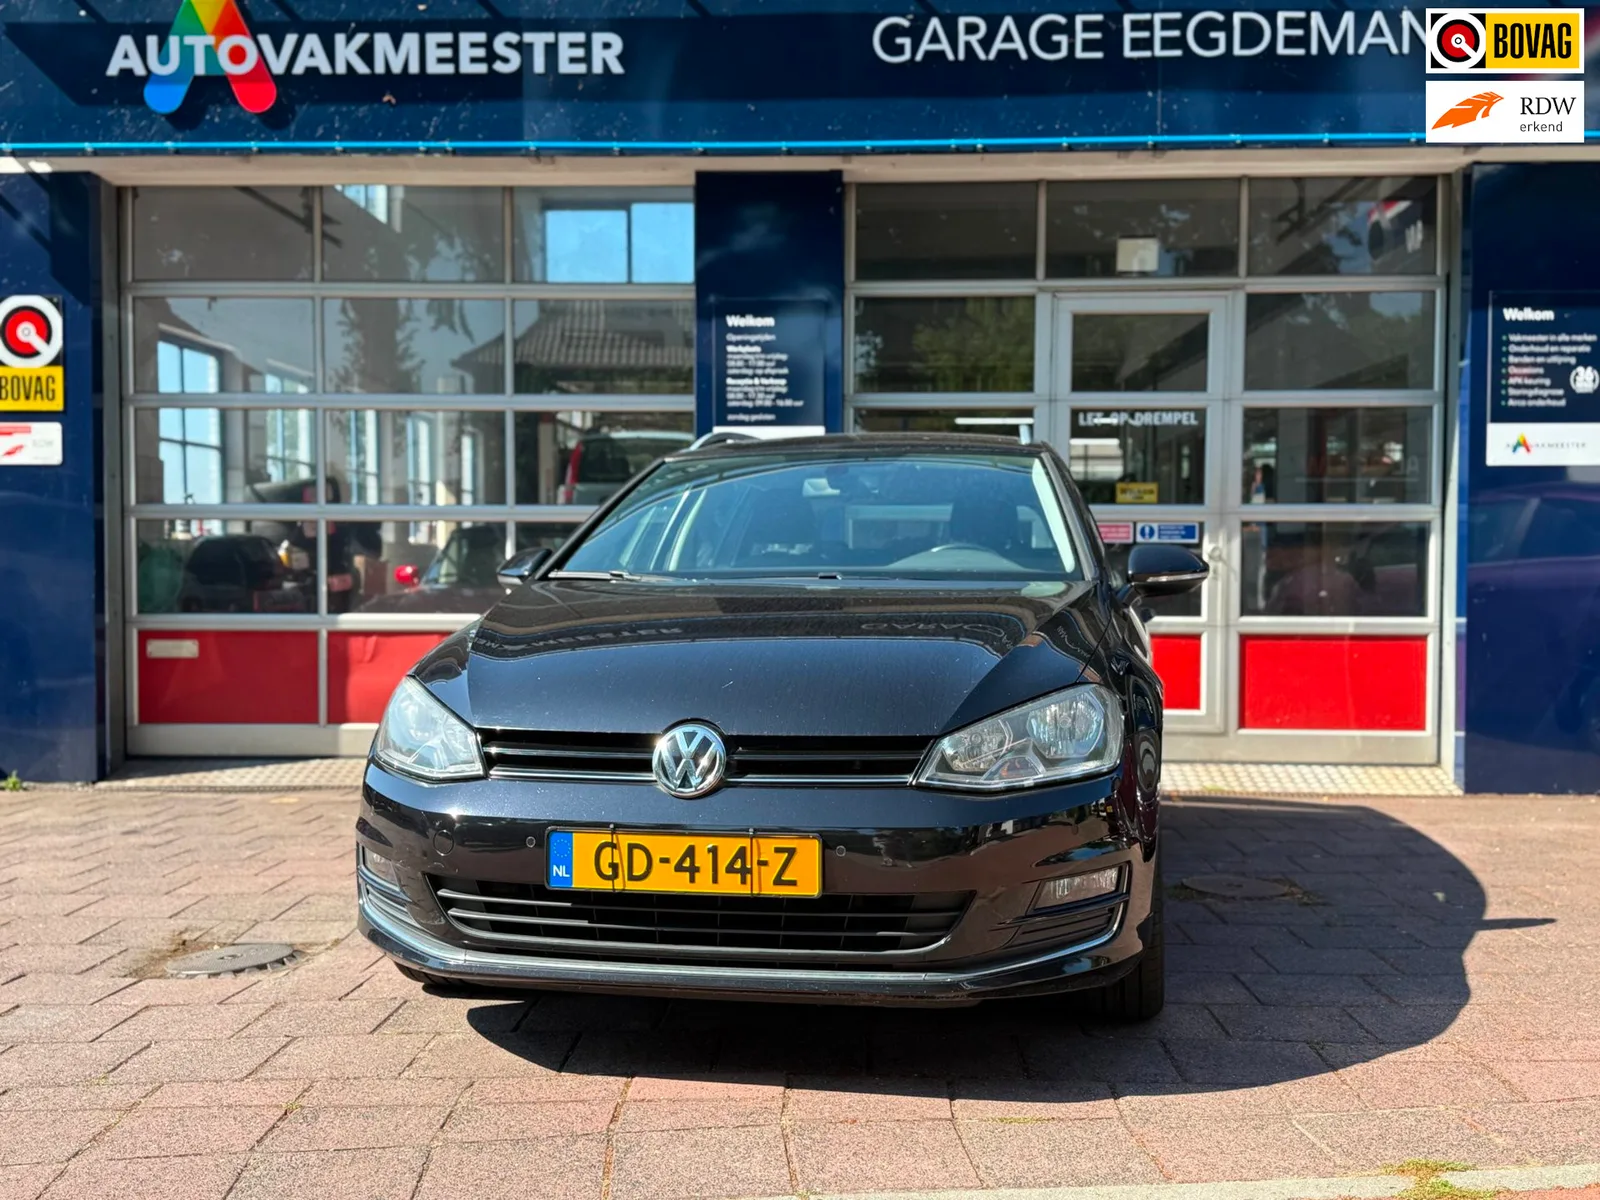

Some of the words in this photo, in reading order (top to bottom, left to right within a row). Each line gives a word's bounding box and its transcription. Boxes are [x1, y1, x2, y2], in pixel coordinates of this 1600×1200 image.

[872, 13, 1105, 64] GARAGE
[105, 31, 625, 77] AUTOVAKMEESTER
[1503, 307, 1556, 321] Welkom
[0, 375, 56, 401] BOVAG
[1134, 411, 1198, 426] DREMPEL
[552, 864, 570, 878] NL
[594, 840, 798, 887] GD-414-Z
